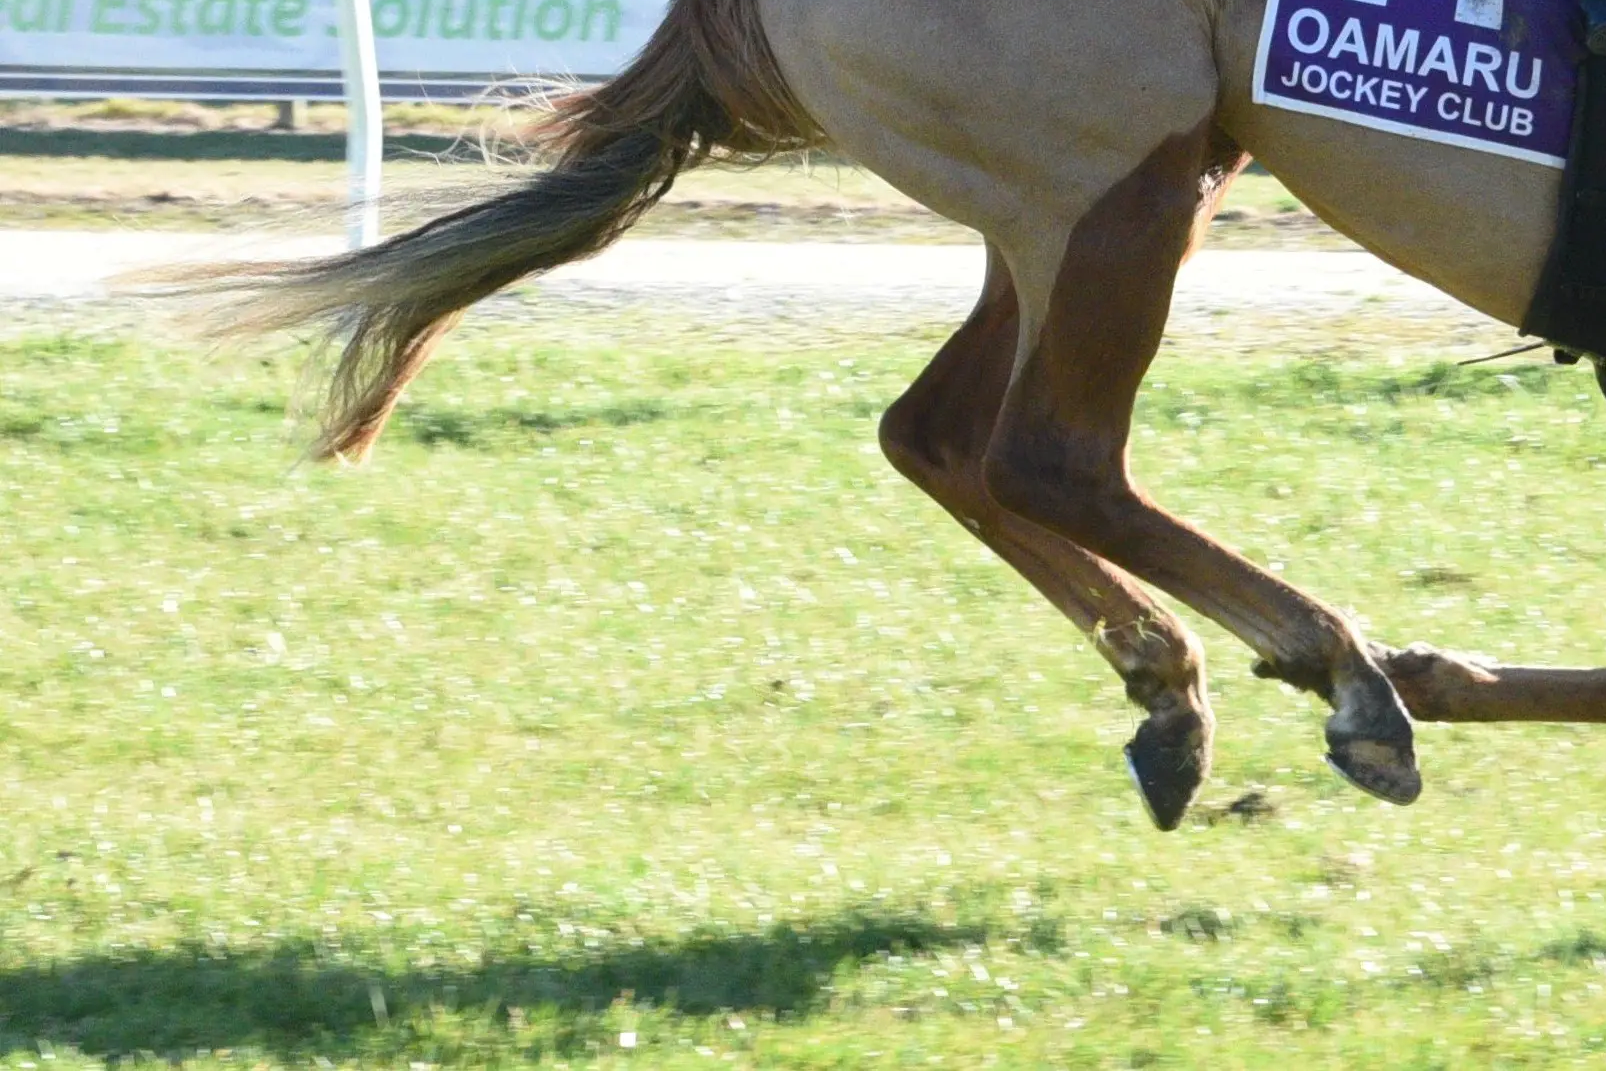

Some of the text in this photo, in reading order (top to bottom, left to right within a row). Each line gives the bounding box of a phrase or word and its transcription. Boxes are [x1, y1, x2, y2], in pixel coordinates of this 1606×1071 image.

[1287, 8, 1542, 99] OAMARU
[1281, 61, 1534, 137] JOCKEY CLUB
